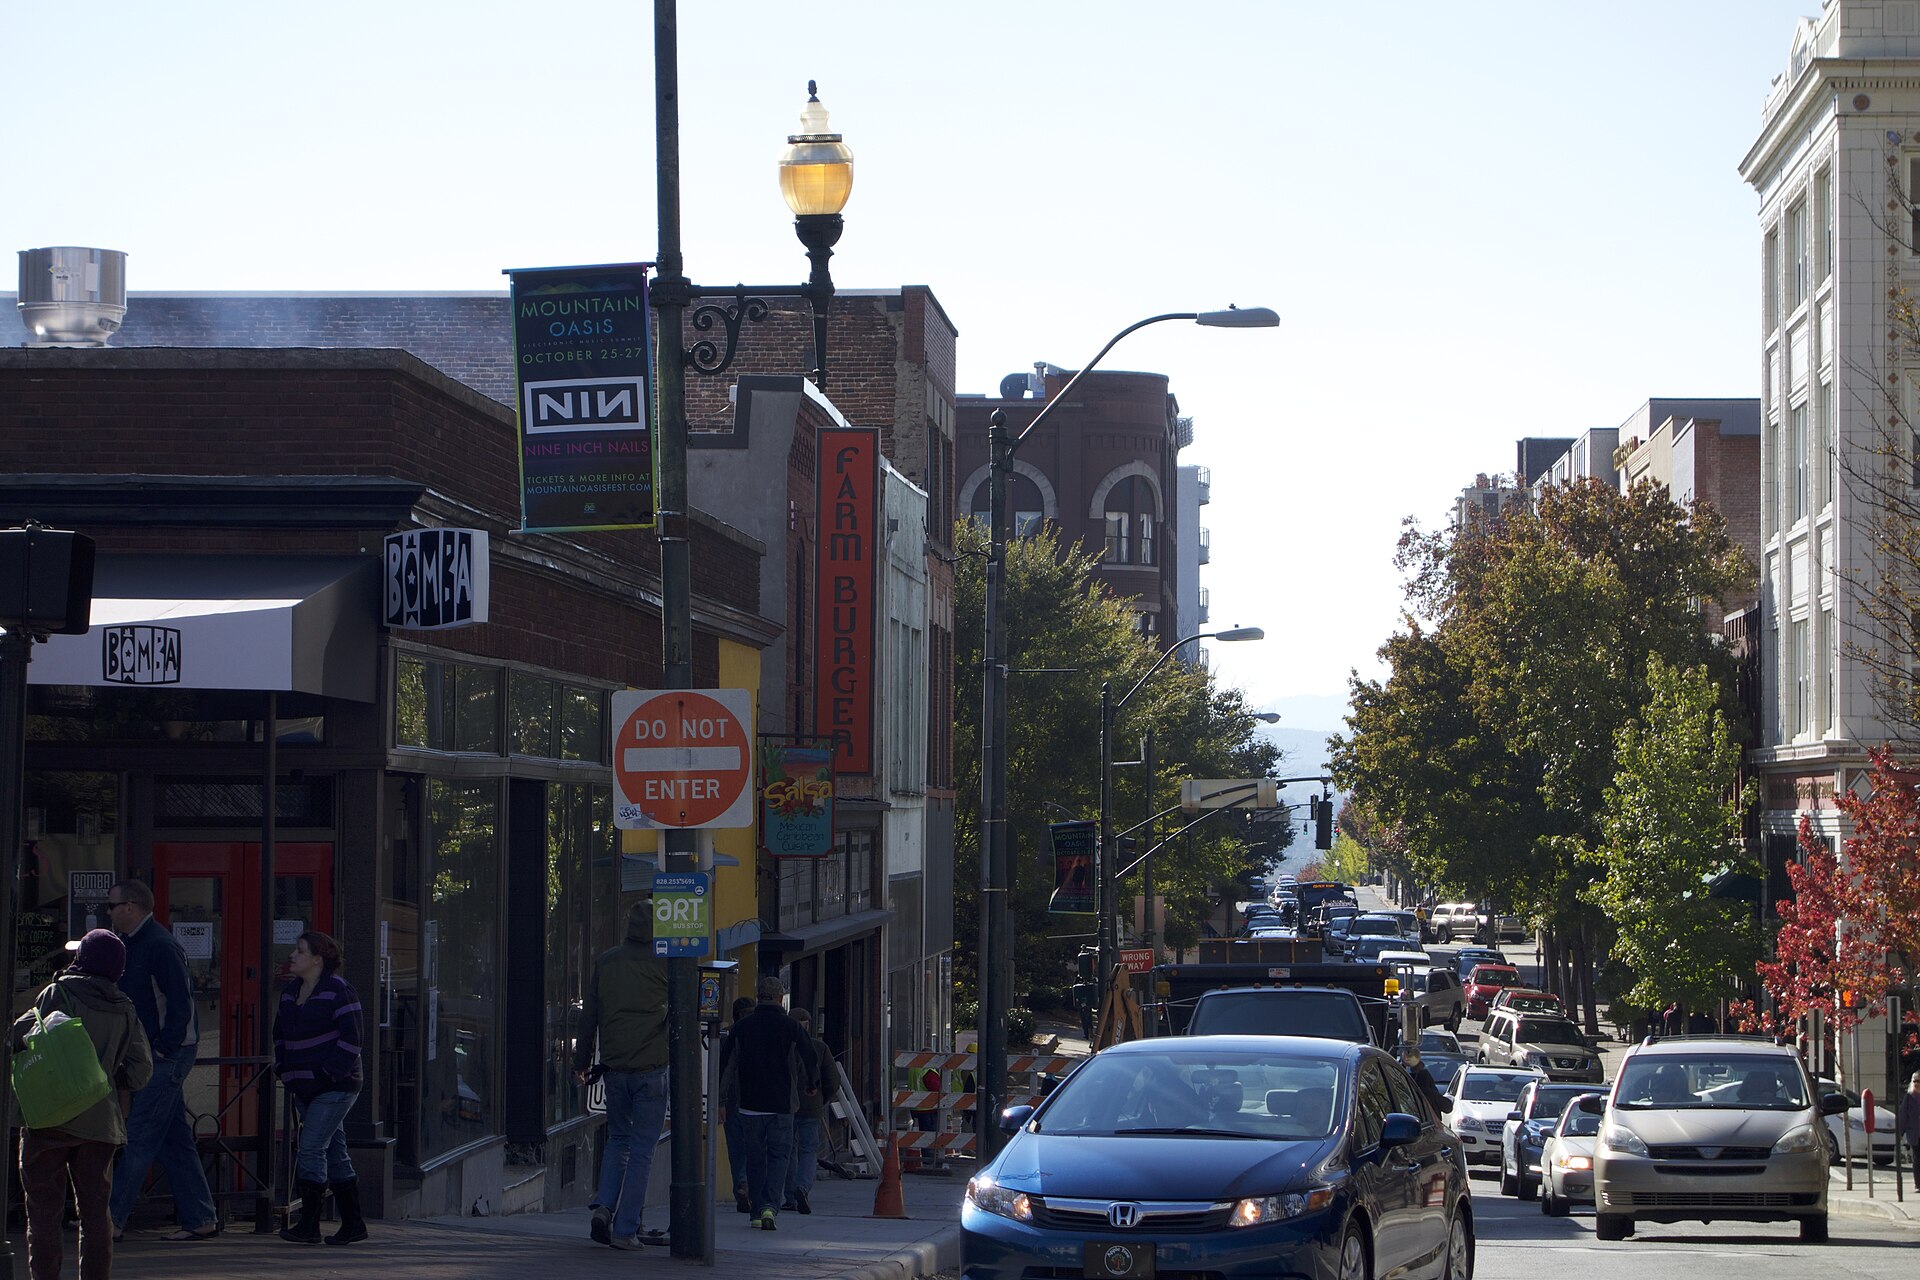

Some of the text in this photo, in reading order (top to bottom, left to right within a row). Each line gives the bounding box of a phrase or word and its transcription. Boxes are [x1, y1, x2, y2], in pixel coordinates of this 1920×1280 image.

[521, 296, 640, 318] MOUNTAIN
[549, 318, 613, 337] OASIS
[522, 347, 642, 364] OCTOBER 25-27
[525, 440, 649, 457] NINE INCH NAILS
[527, 472, 651, 485] TICKETS & MORE INFO AT
[526, 483, 652, 495] MOUNTAINOASISFEST.COM
[830, 447, 862, 561] FARM
[831, 576, 858, 757] BURGER
[635, 718, 729, 740] DO NOT
[645, 778, 720, 800] ENTER
[764, 775, 833, 809] Salsa
[780, 822, 817, 832] Mexican
[776, 831, 824, 841] Caribbean
[781, 841, 815, 852] Cuisine
[73, 873, 110, 889] BOMBA
[1121, 952, 1150, 962] WRONG
[1127, 961, 1145, 970] WAY
